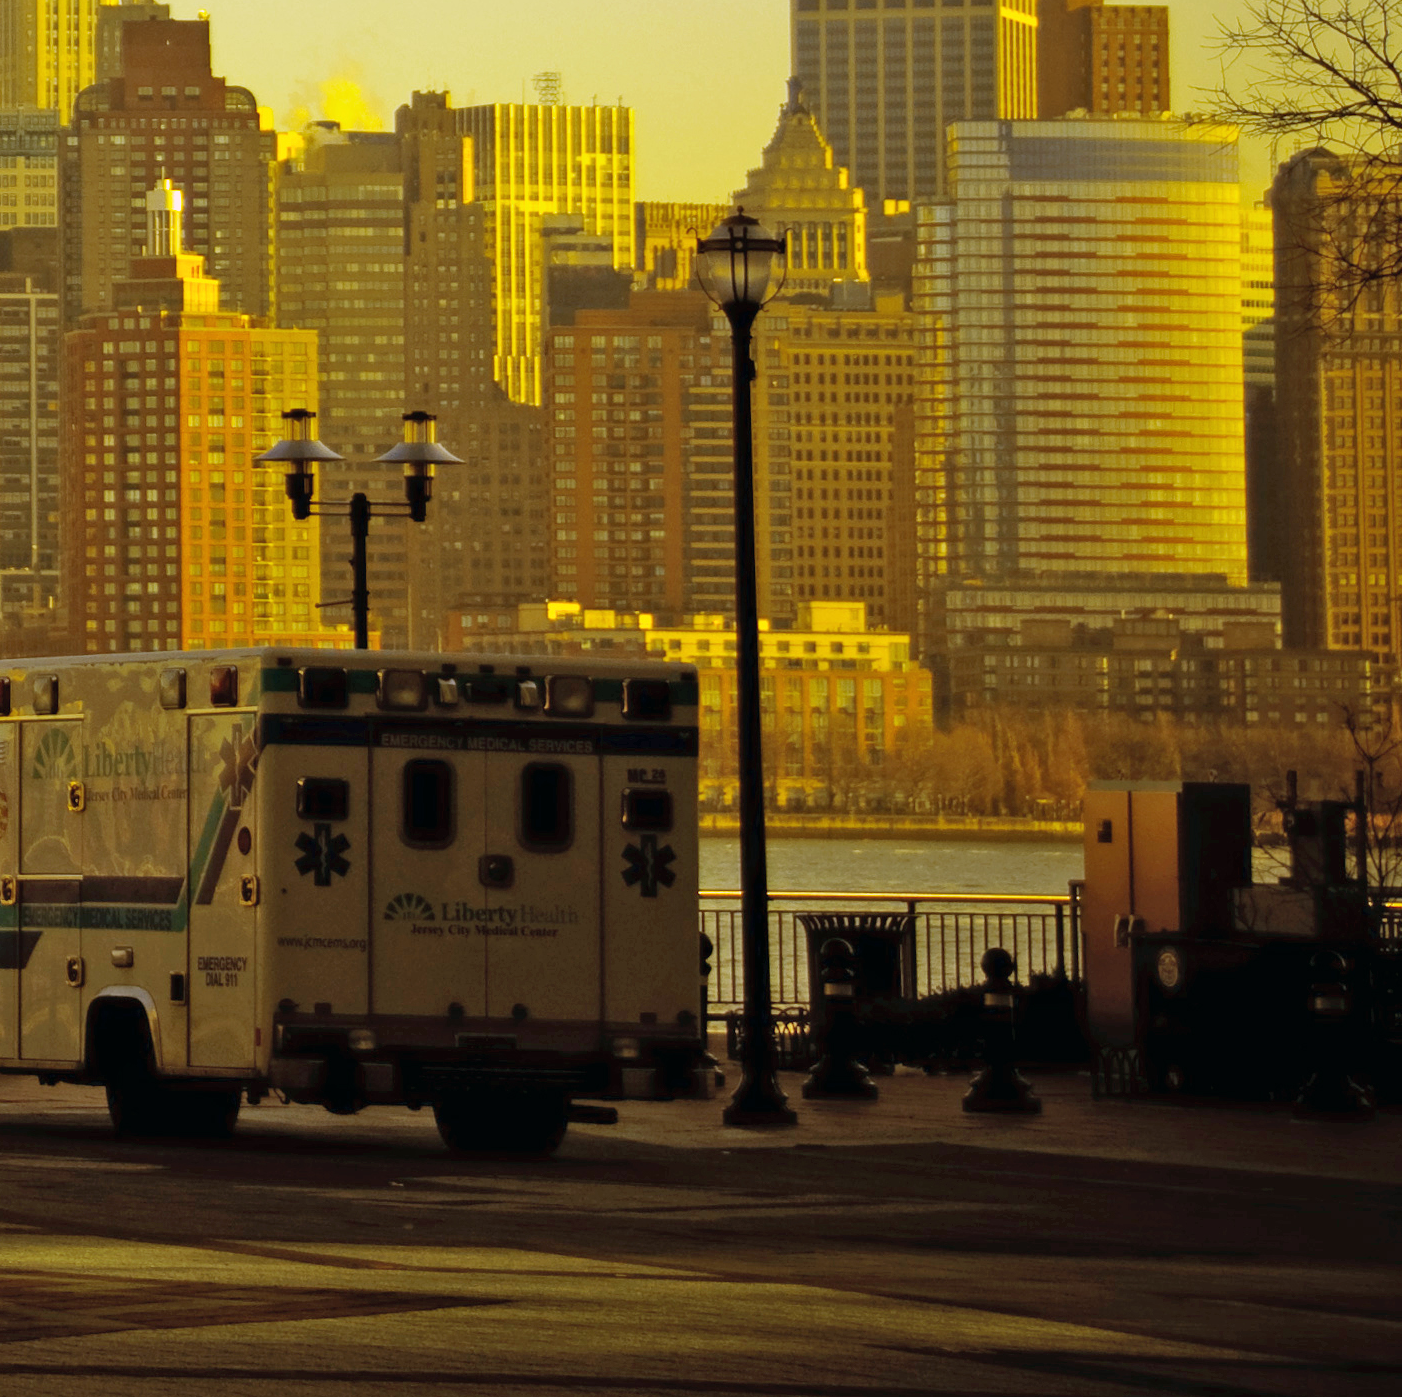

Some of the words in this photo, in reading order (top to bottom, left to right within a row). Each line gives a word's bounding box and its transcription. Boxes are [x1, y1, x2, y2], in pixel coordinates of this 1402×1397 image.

[381, 734, 463, 750] EMERGENCY
[467, 737, 526, 752] MEDICAL
[529, 739, 594, 754] SERVICES
[125, 908, 172, 931] SERVICES
[411, 923, 444, 937] Jersey
[448, 923, 470, 938] City
[475, 924, 517, 937] Medical
[521, 926, 557, 938] Center
[197, 957, 247, 971] EMERGENCY
[205, 973, 224, 987] DIAL
[225, 974, 238, 987] 911
